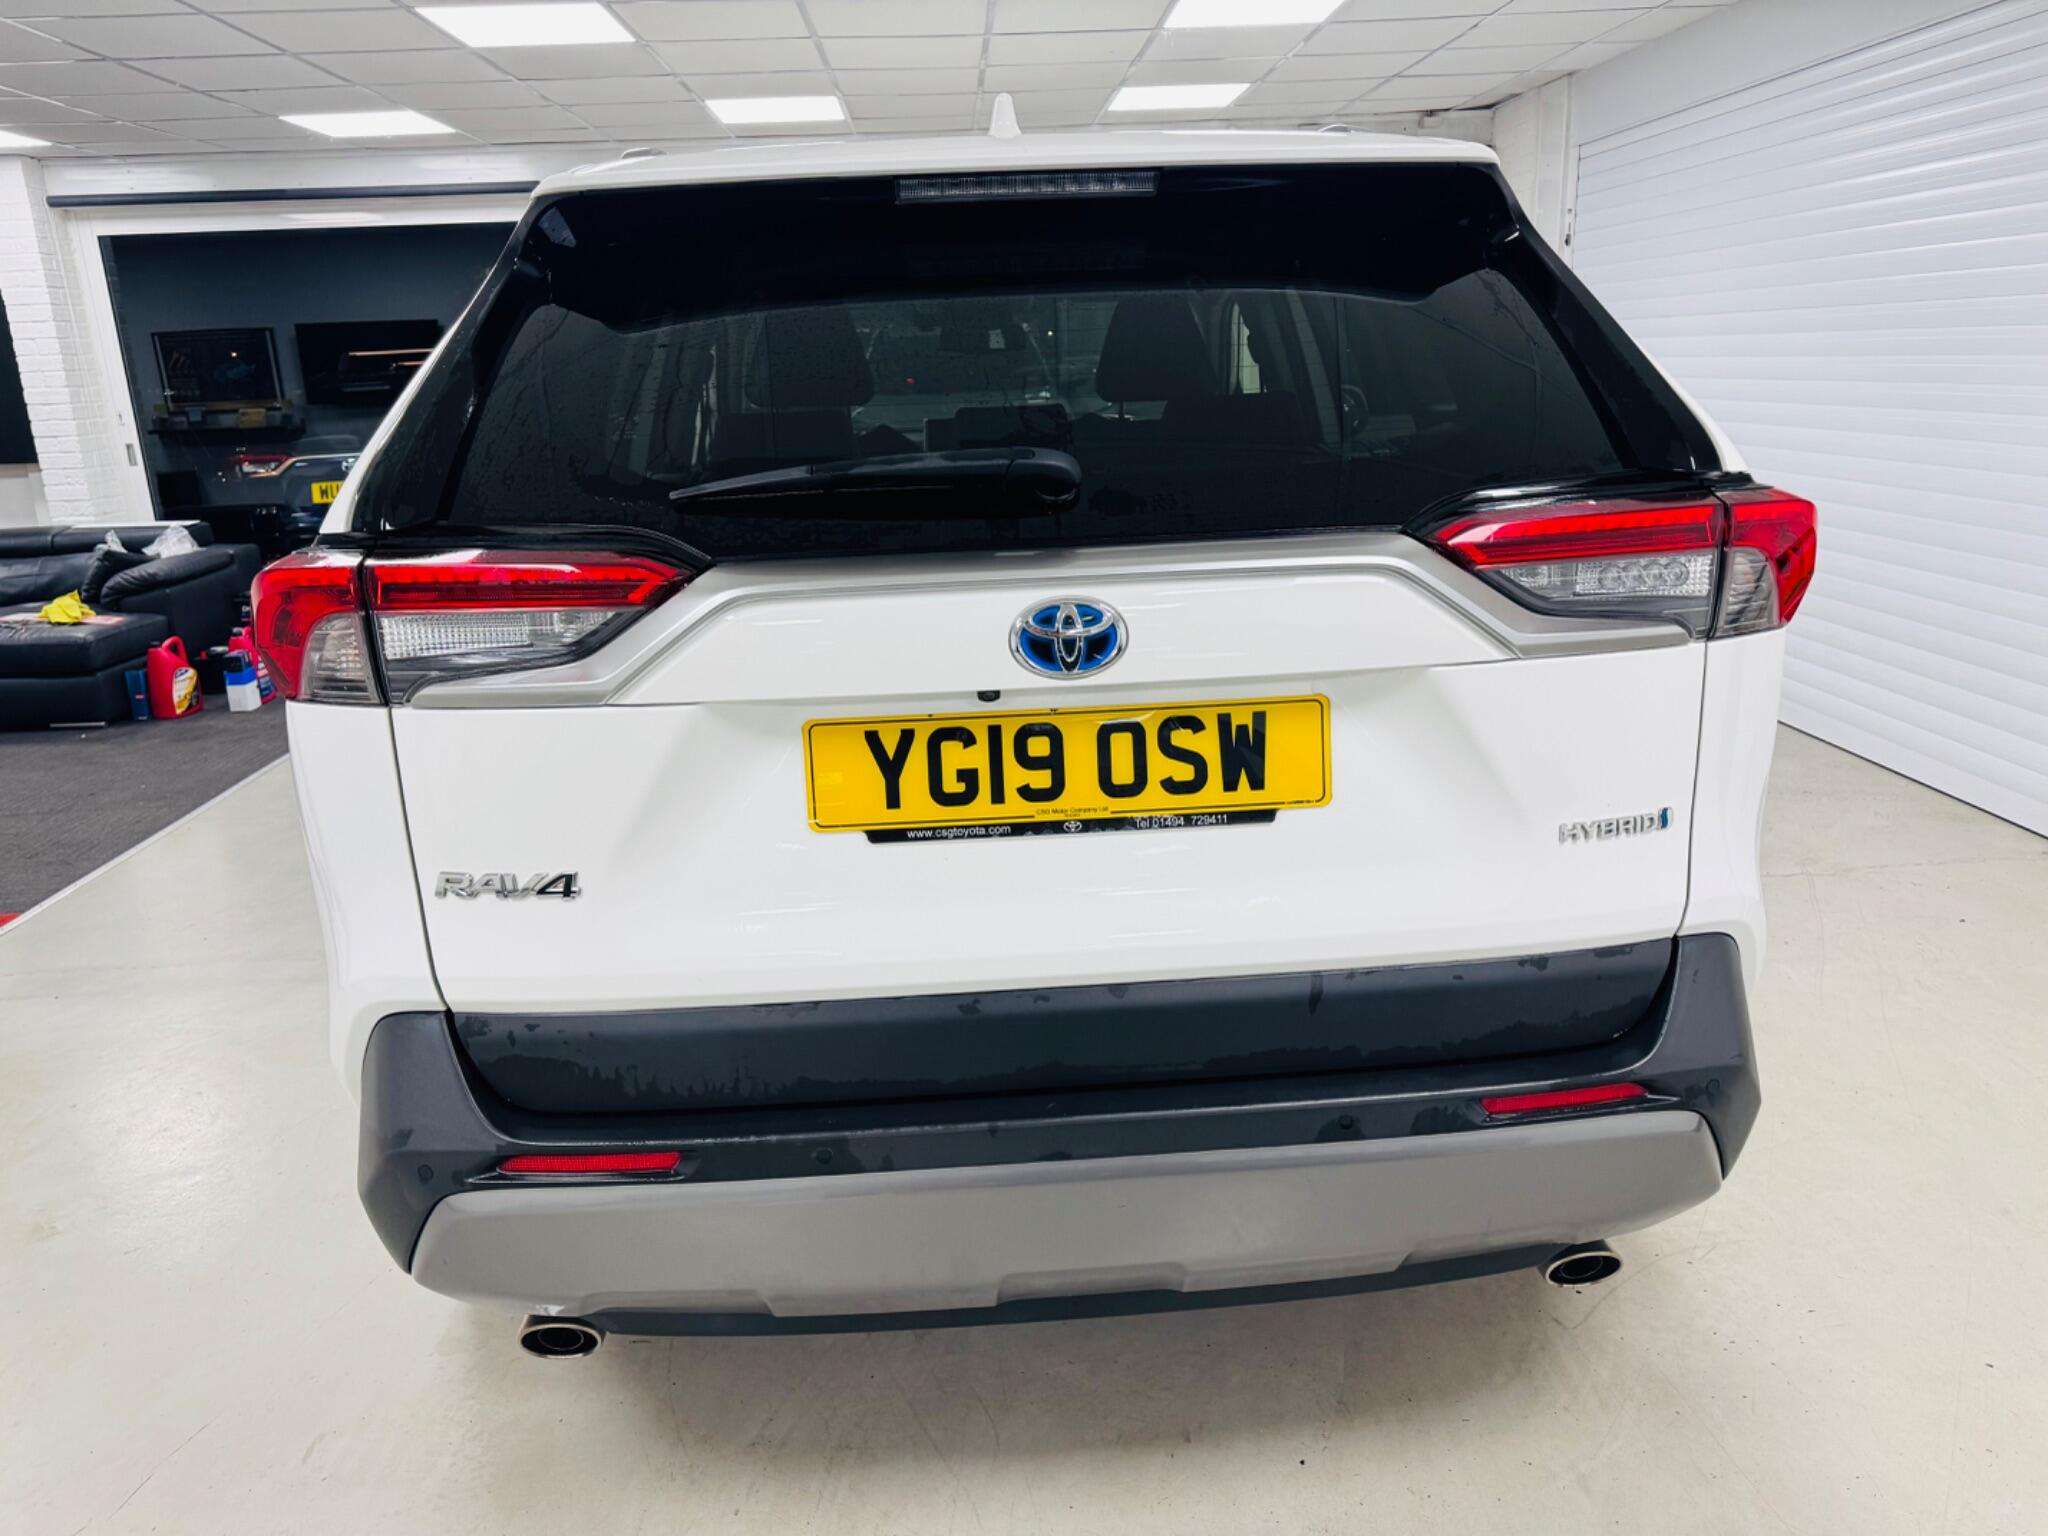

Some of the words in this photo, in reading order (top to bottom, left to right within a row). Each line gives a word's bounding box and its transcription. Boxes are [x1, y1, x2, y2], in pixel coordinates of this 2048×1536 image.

[864, 722, 1066, 810] YG19
[1096, 710, 1267, 799] OSW
[906, 825, 1012, 840] www.csgtoyota.com
[1135, 817, 1150, 829] Tel
[1152, 815, 1185, 828] 01494
[1190, 813, 1229, 826] 729411
[1558, 813, 1657, 842] HYBRID
[435, 871, 582, 901] RAV4
